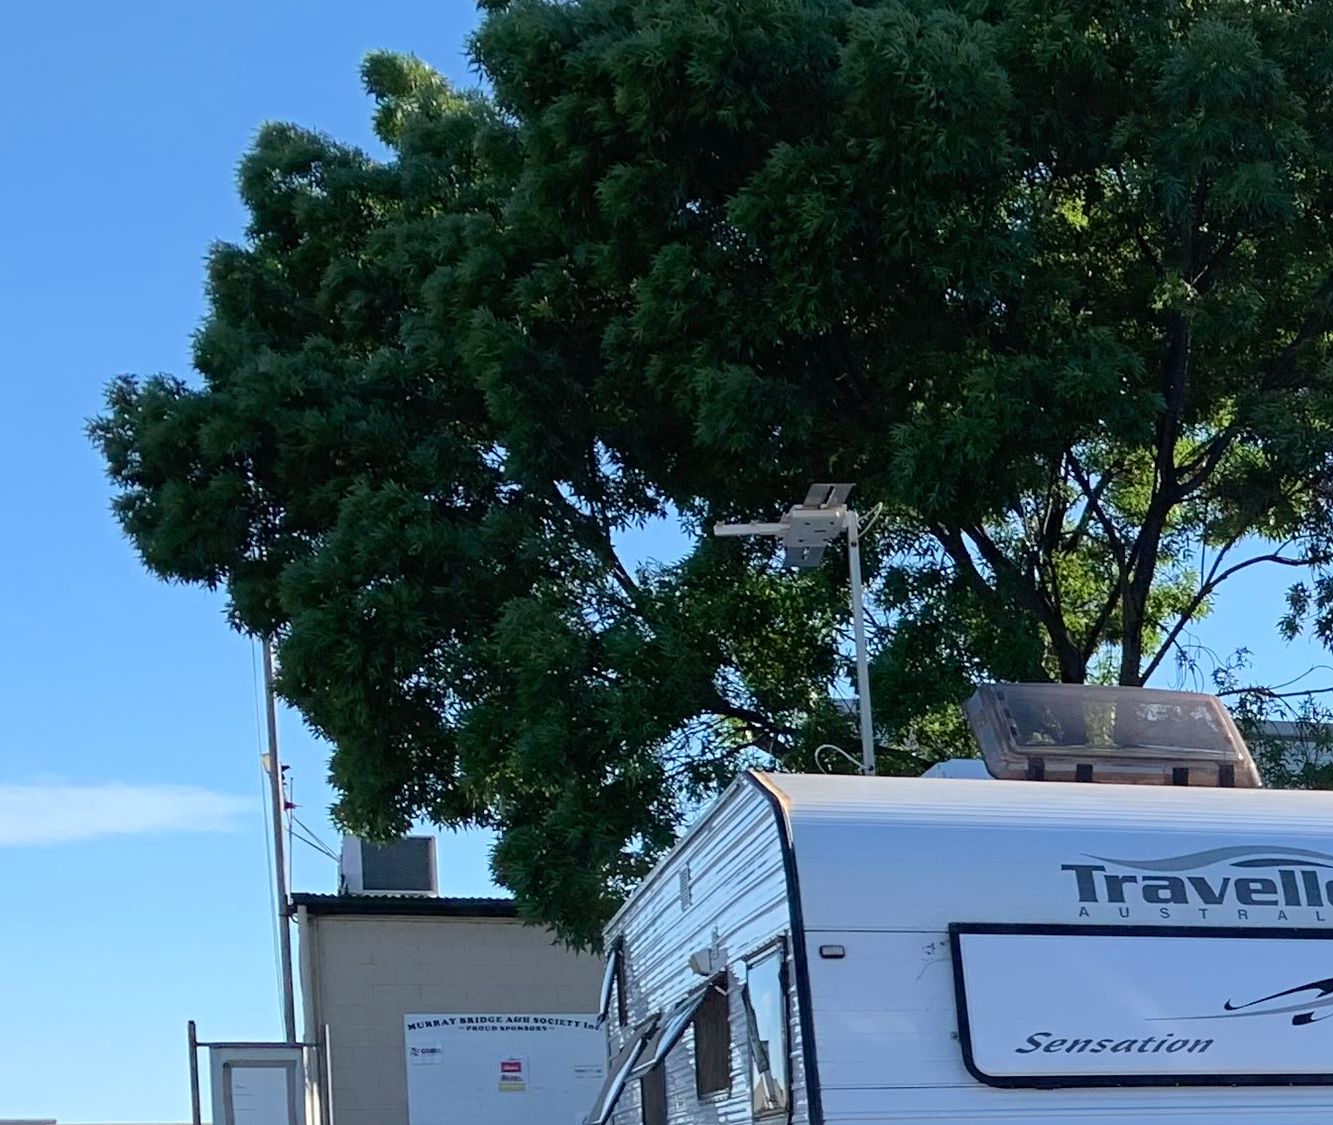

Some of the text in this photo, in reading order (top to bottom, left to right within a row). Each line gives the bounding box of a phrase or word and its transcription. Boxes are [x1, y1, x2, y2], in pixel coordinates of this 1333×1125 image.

[407, 1017, 456, 1030] MURRAY
[459, 1016, 502, 1024] BRIDGE
[533, 1017, 581, 1028] SOCIETY
[584, 1021, 601, 1032] In
[1015, 1031, 1214, 1055] Sensation
